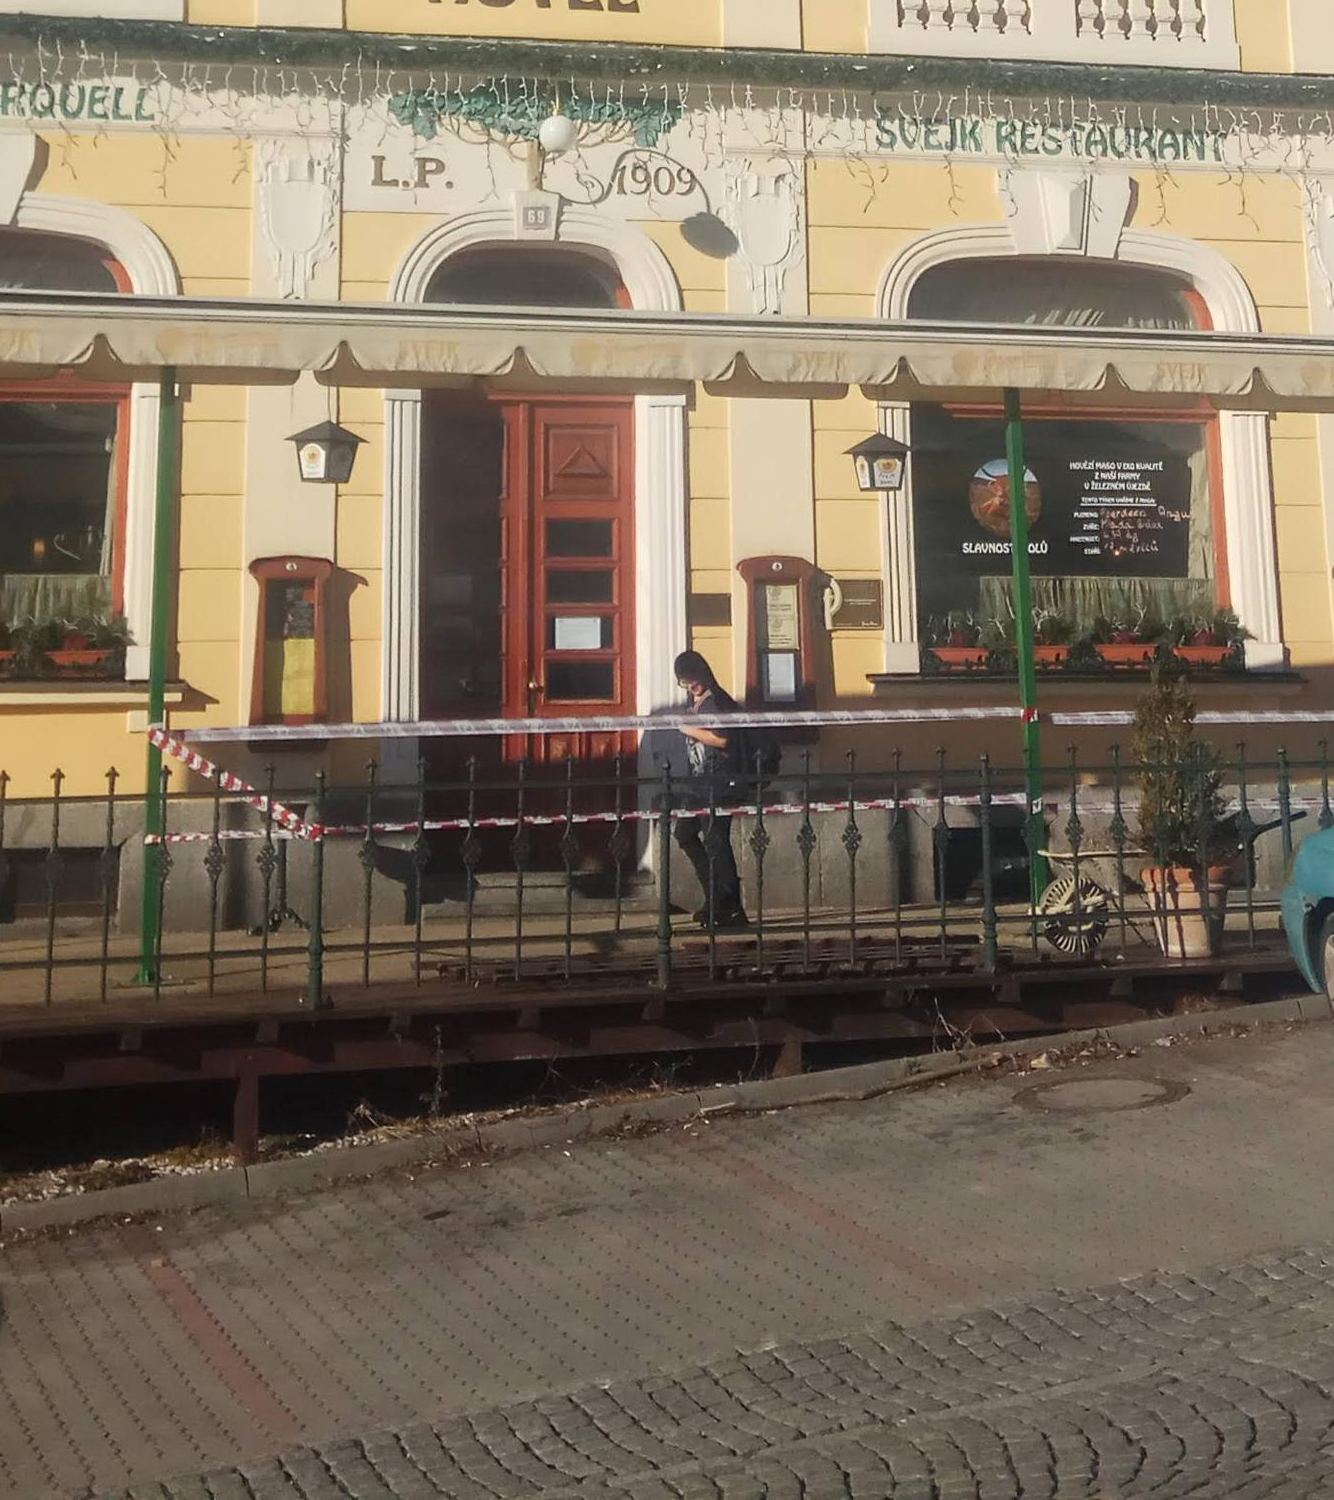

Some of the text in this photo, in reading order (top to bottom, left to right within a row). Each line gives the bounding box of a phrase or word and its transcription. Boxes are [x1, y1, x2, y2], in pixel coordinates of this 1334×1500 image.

[875, 106, 1229, 163] ŠVEJK RESTAURANT
[370, 155, 455, 190] L.P.
[614, 163, 699, 197] 1909
[526, 209, 545, 224] 69
[1095, 461, 1116, 470] MASO
[962, 539, 1048, 554] SLAVNOST OLŮ
